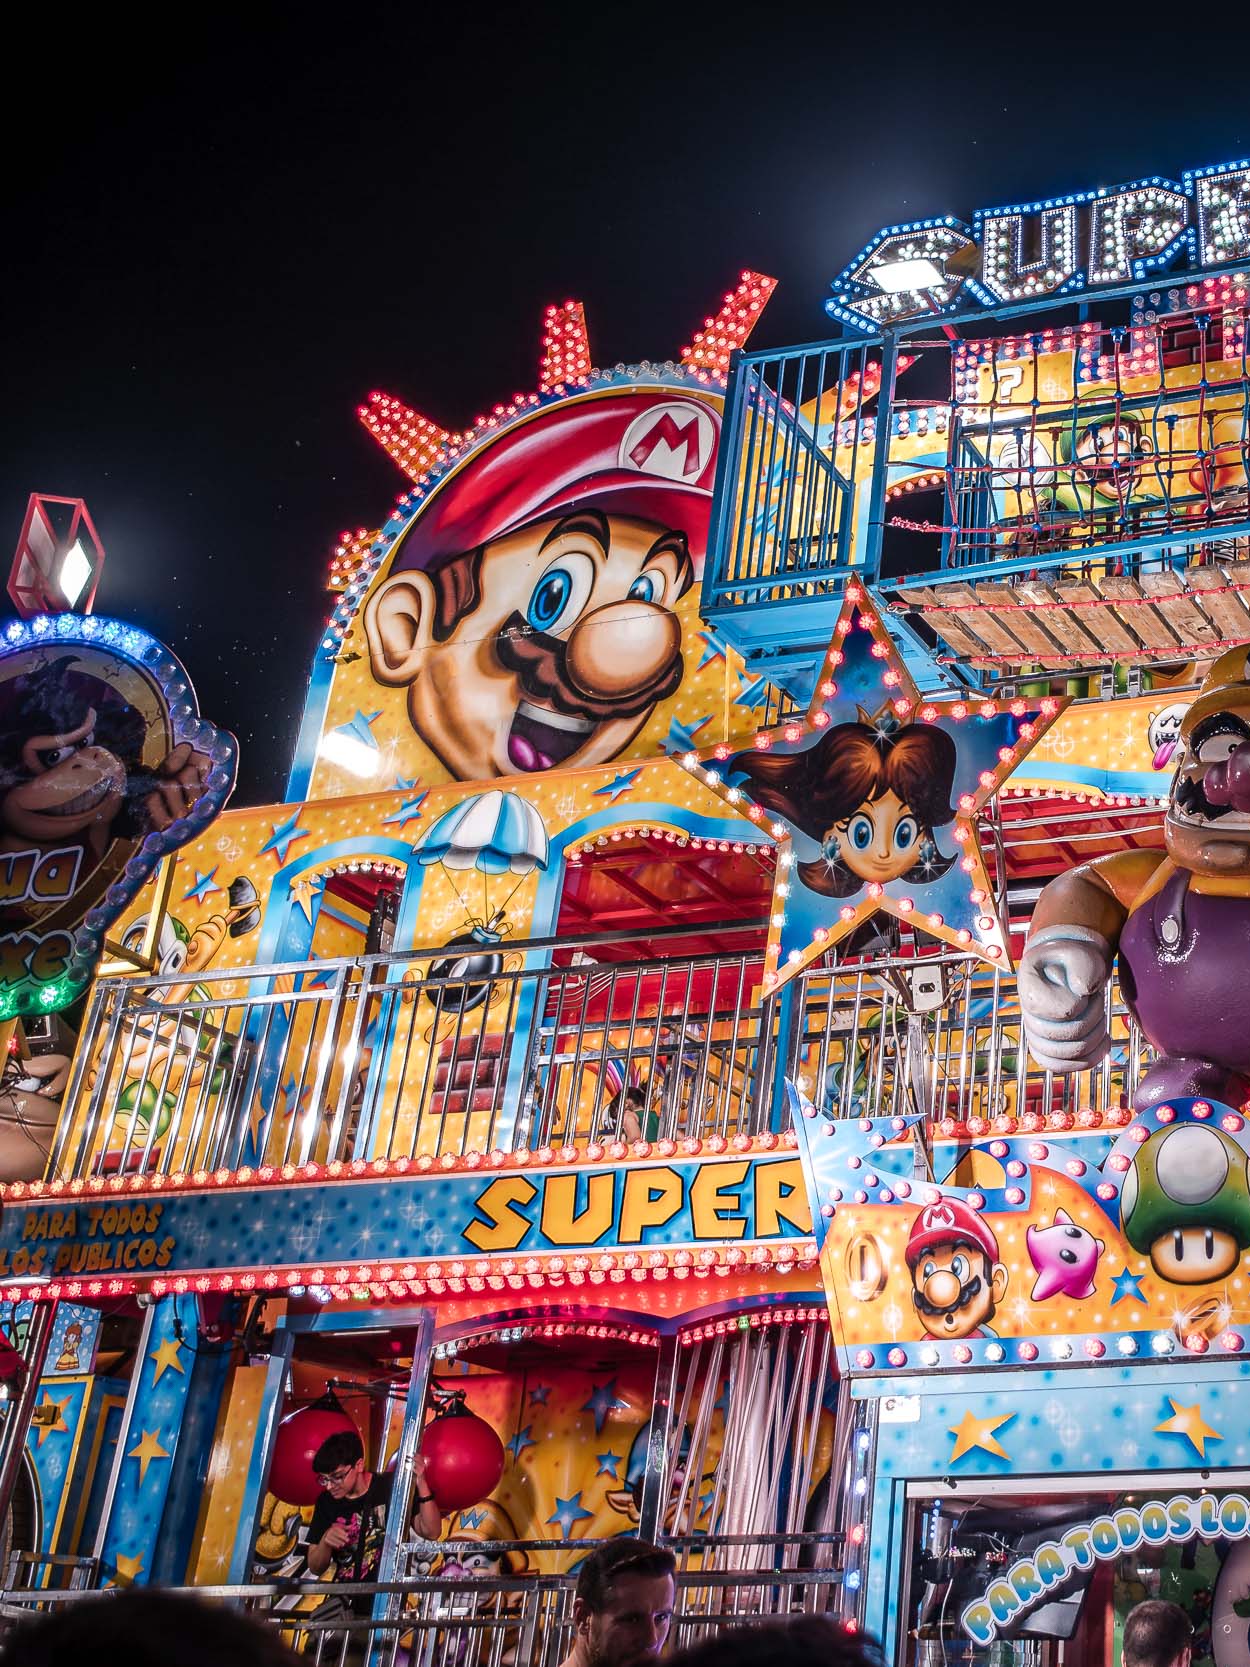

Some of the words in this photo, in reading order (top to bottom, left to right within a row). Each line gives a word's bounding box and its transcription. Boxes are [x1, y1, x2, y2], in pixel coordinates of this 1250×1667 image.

[629, 412, 701, 477] M
[0, 847, 83, 902] ua
[0, 931, 74, 984] xe
[22, 1209, 77, 1241] PARA
[88, 1202, 164, 1237] TODOS
[460, 1158, 815, 1252] SUPER
[0, 1246, 48, 1276] LOS
[53, 1235, 176, 1275] PUBLICOS
[964, 1545, 1067, 1643] PARA
[1063, 1498, 1191, 1566] TODOS
